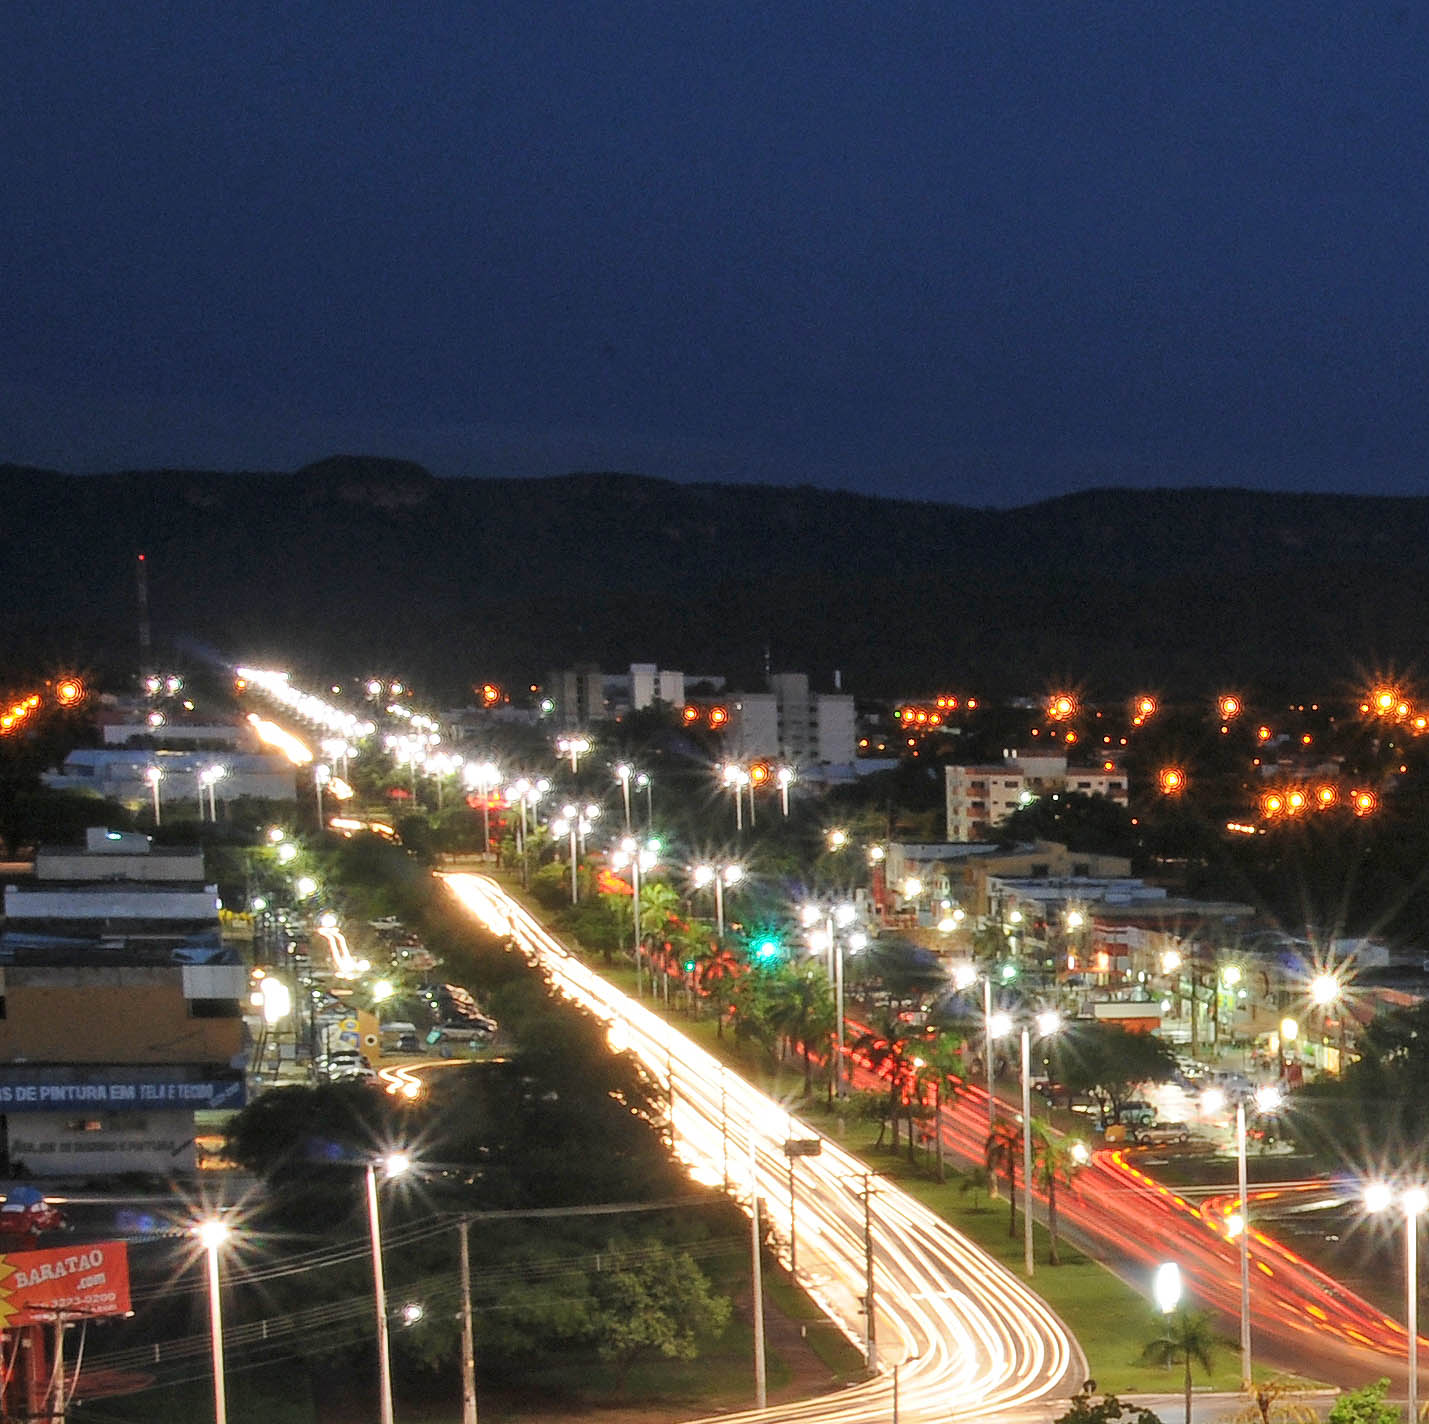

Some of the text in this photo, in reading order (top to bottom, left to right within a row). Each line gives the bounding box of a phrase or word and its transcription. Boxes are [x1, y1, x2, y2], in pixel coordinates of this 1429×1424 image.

[15, 1086, 38, 1101] DE
[40, 1085, 107, 1101] PINTURA
[110, 1084, 136, 1101] EM
